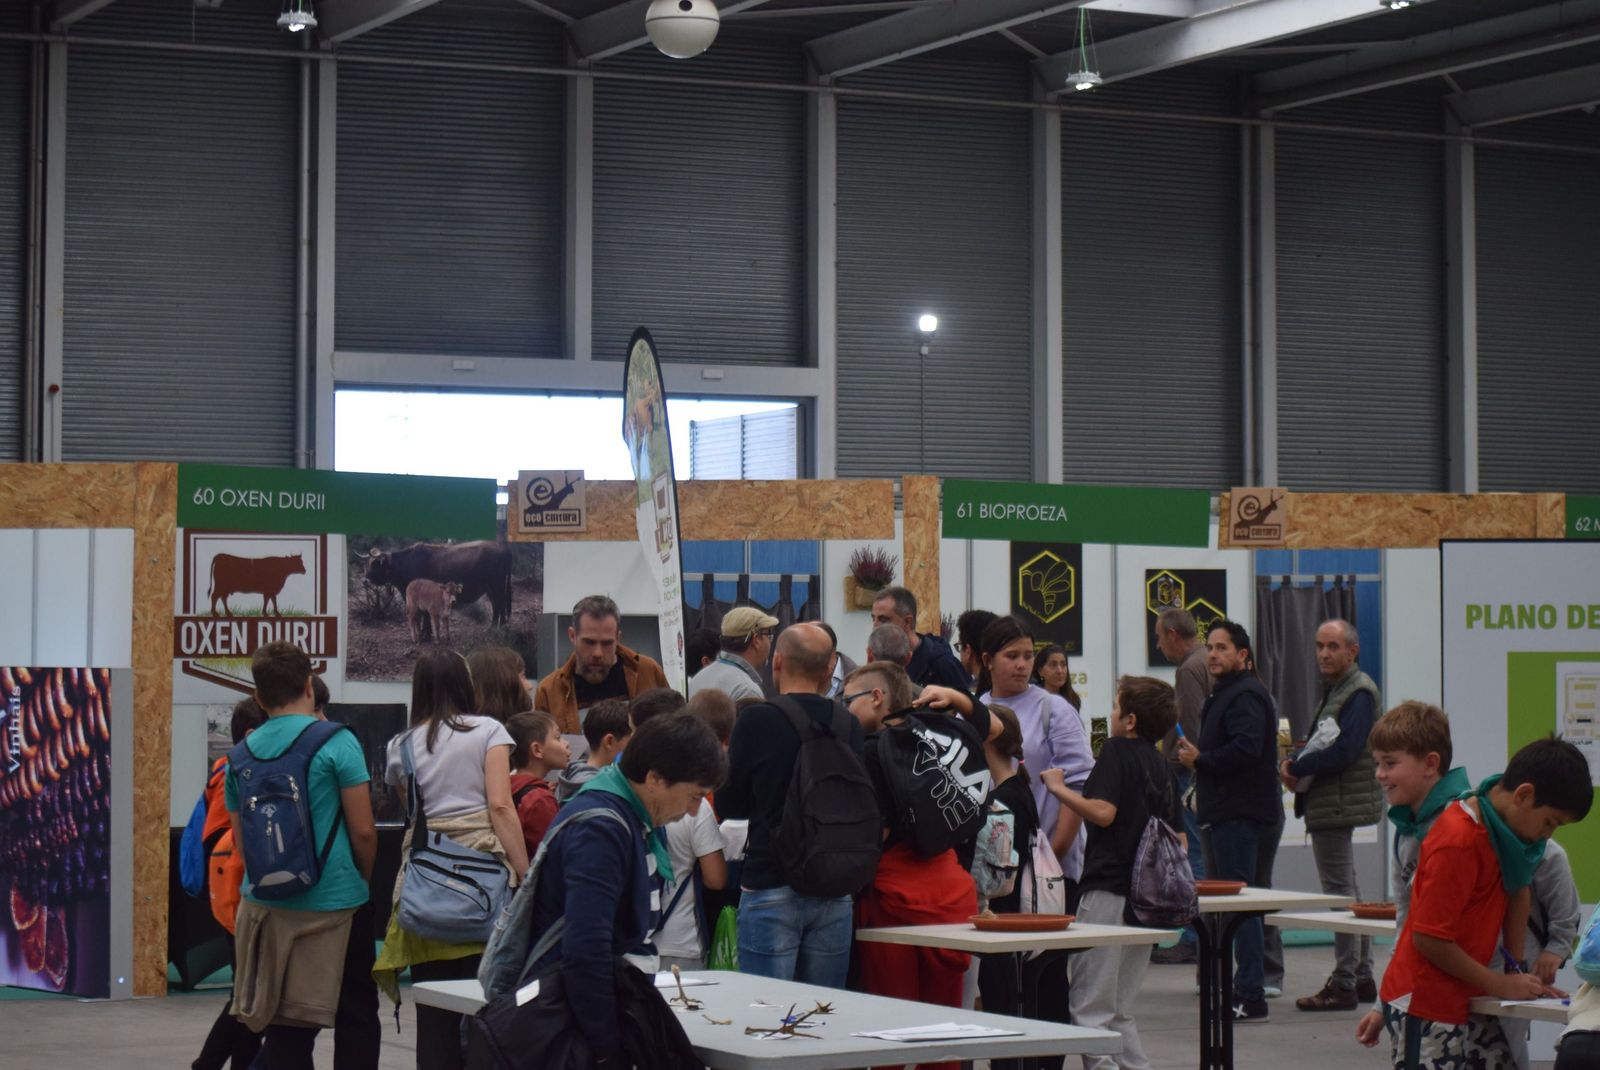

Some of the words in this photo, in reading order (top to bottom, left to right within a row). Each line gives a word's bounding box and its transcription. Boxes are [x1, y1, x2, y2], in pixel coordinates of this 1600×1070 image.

[193, 488, 215, 506] 60
[220, 489, 273, 508] OXEN
[279, 492, 326, 511] DURII
[957, 502, 973, 519] 61
[980, 503, 1068, 522] BIOPROEZA
[1576, 516, 1591, 532] 62
[1465, 603, 1558, 630] PLANO
[1567, 603, 1600, 630] DE
[181, 621, 248, 655] OXEN
[257, 621, 326, 655] DURII
[8, 686, 21, 774] Vinhais
